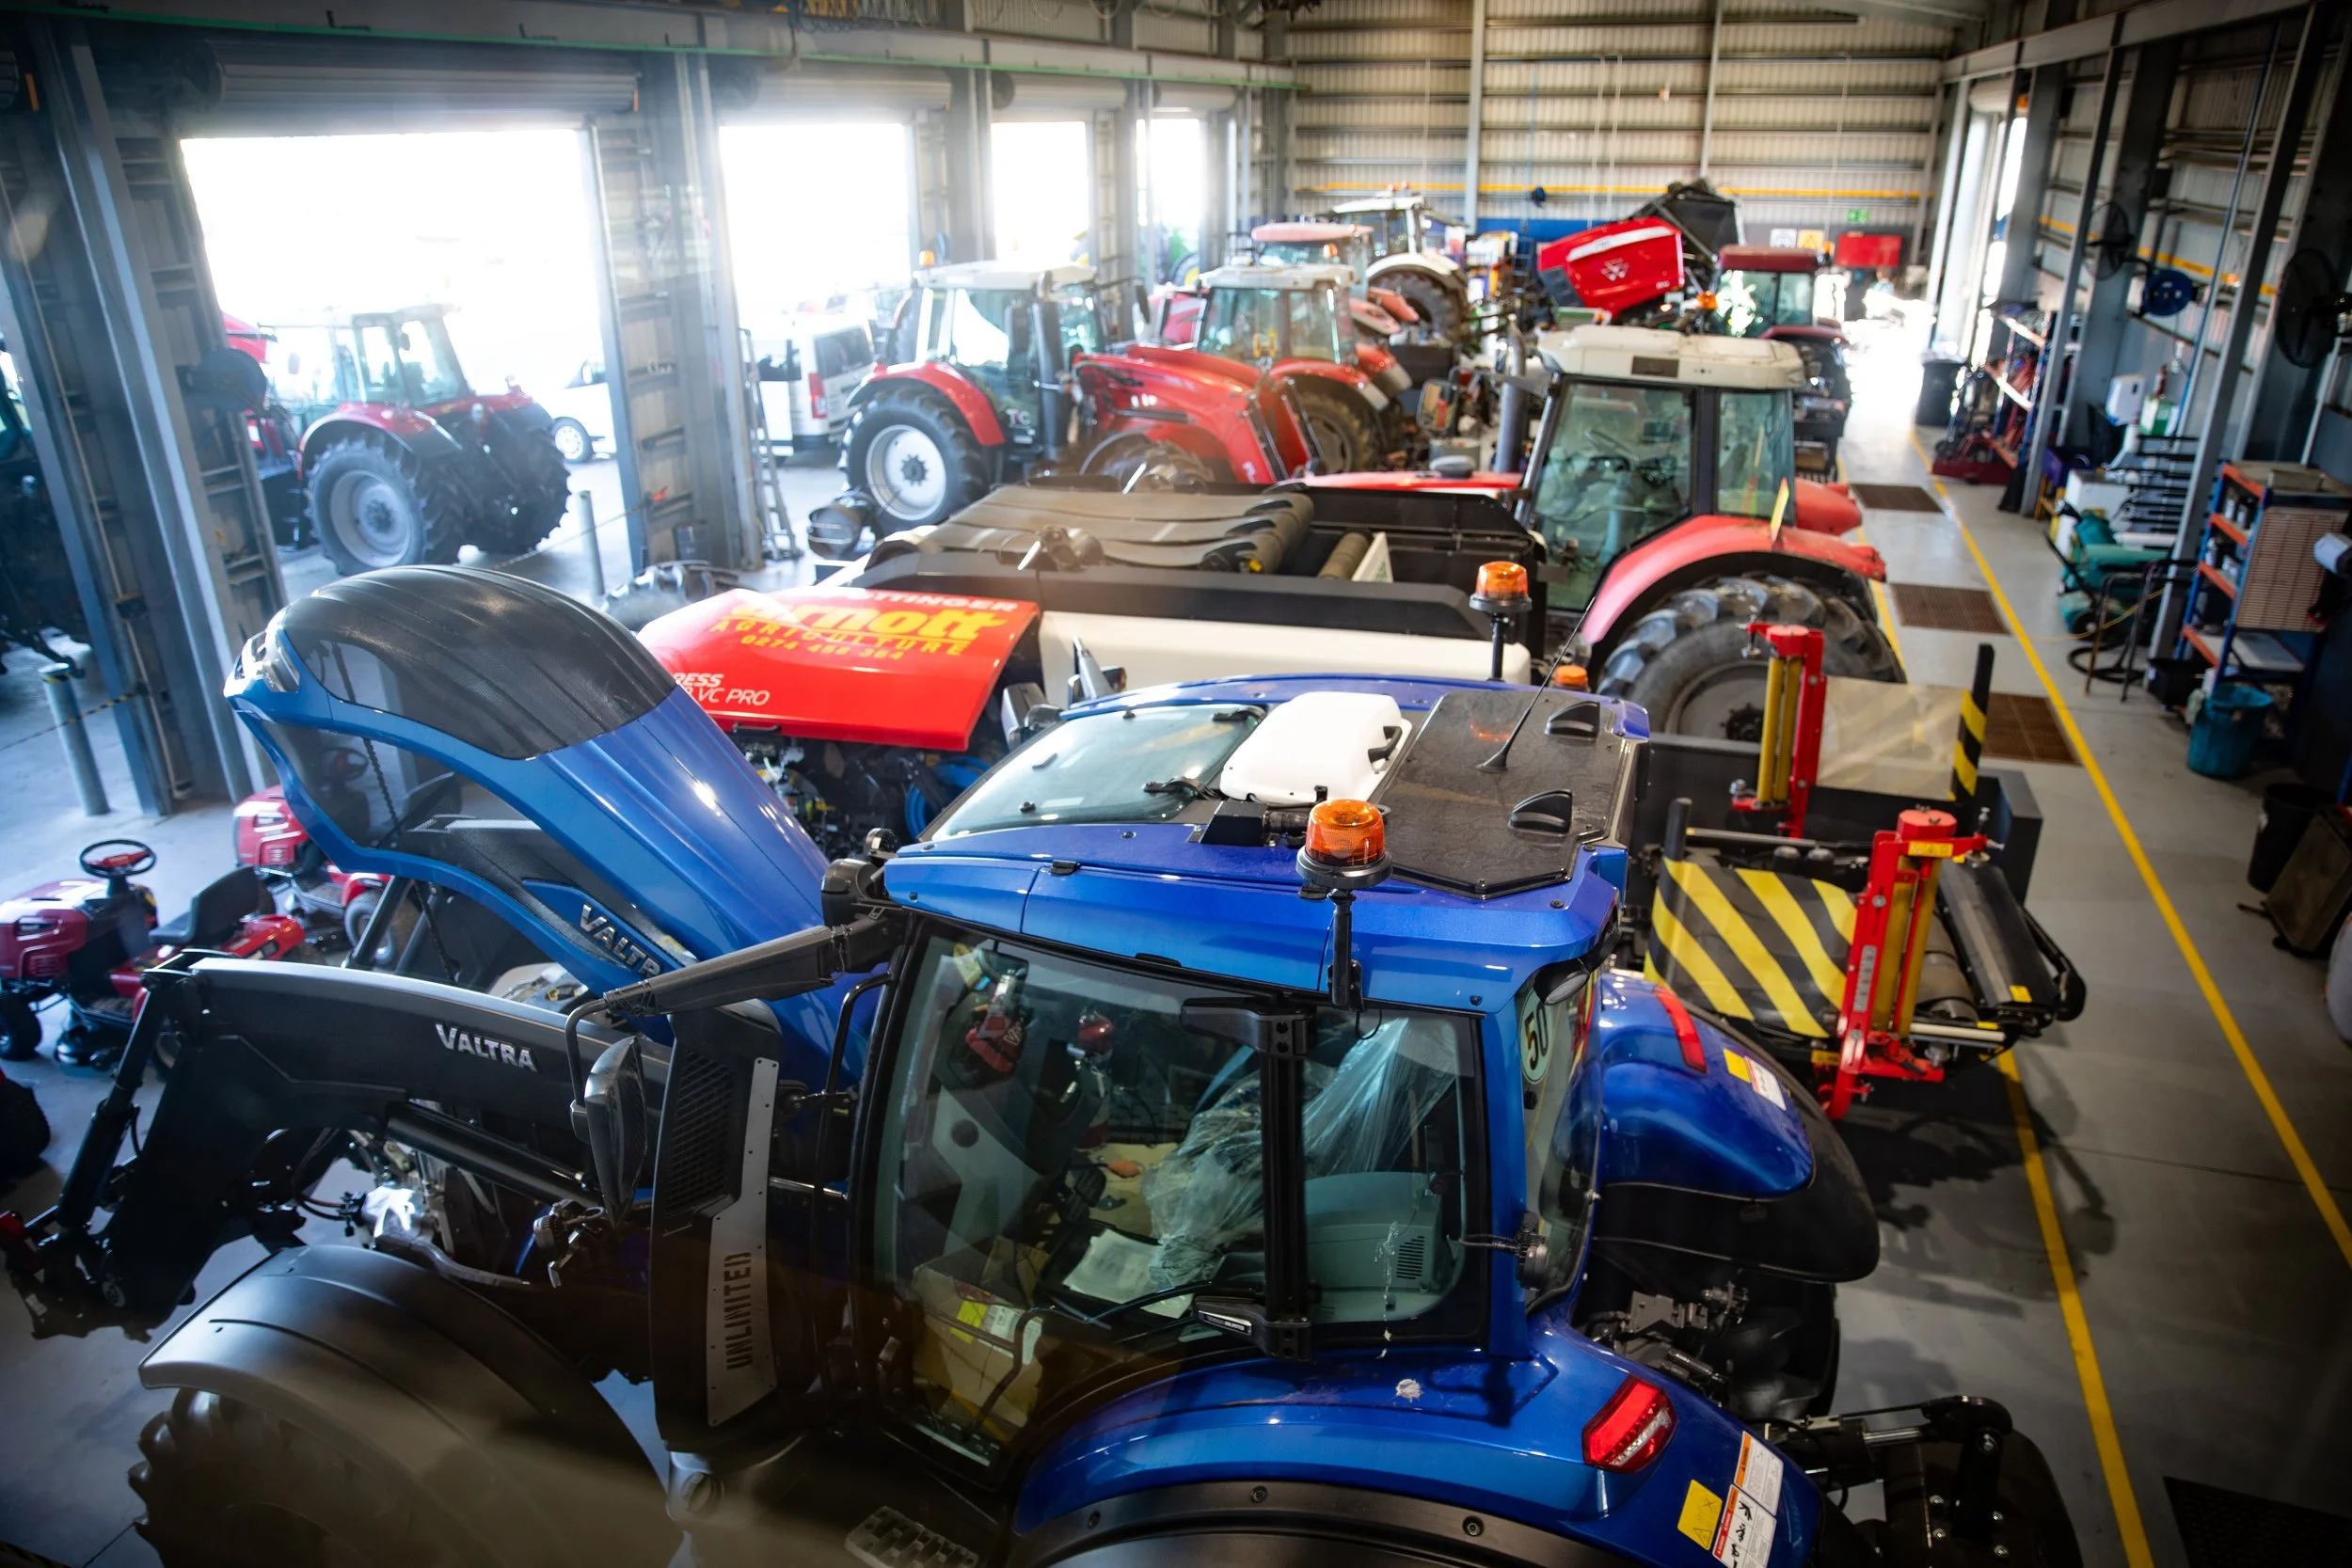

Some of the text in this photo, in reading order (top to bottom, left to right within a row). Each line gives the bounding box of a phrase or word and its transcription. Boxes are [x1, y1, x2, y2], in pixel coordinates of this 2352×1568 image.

[709, 619, 972, 656] AGRICULTURE
[724, 688, 771, 706] PRO
[435, 1022, 538, 1072] VALTRA
[1524, 1003, 1549, 1070] 50
[723, 1252, 753, 1370] UNLIMITED
